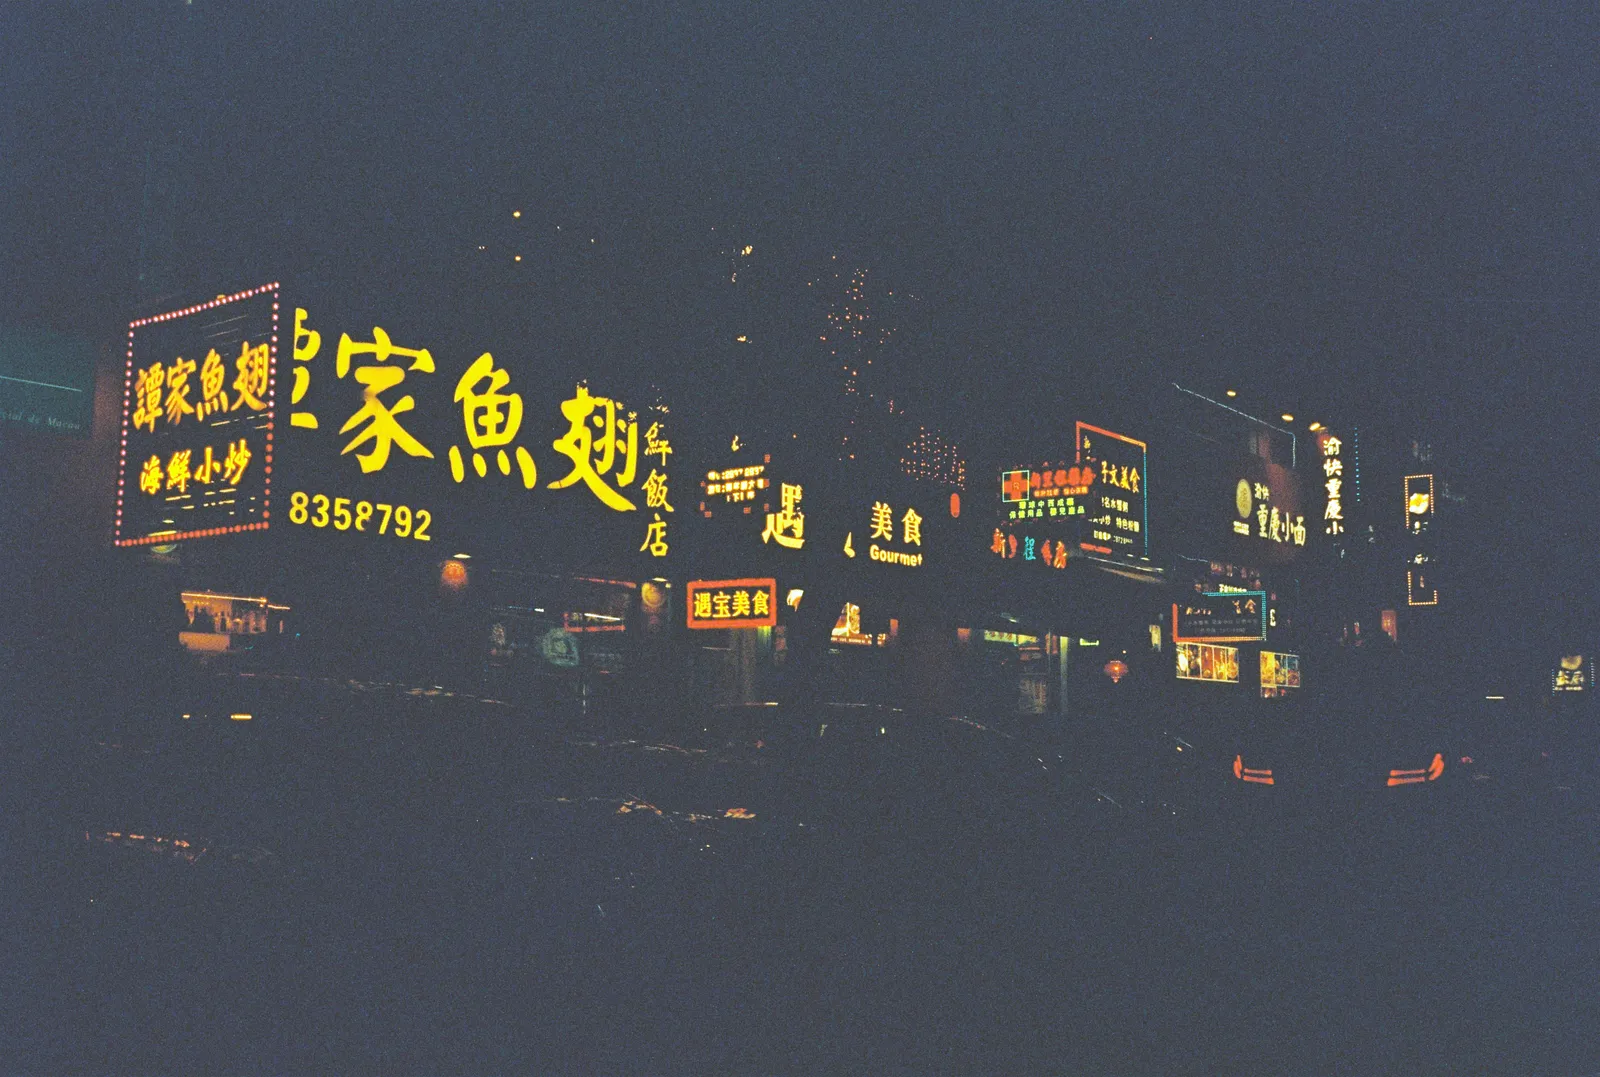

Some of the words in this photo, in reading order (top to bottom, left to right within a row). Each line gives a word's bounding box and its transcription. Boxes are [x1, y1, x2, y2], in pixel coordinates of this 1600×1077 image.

[132, 340, 270, 433] 譚家魚翅
[139, 438, 252, 494] 海鮮小炒
[640, 397, 675, 557] 鮮飯店
[289, 491, 433, 541] 8358792
[869, 544, 923, 567] Gourmet
[693, 589, 770, 618] 遇宝美食
